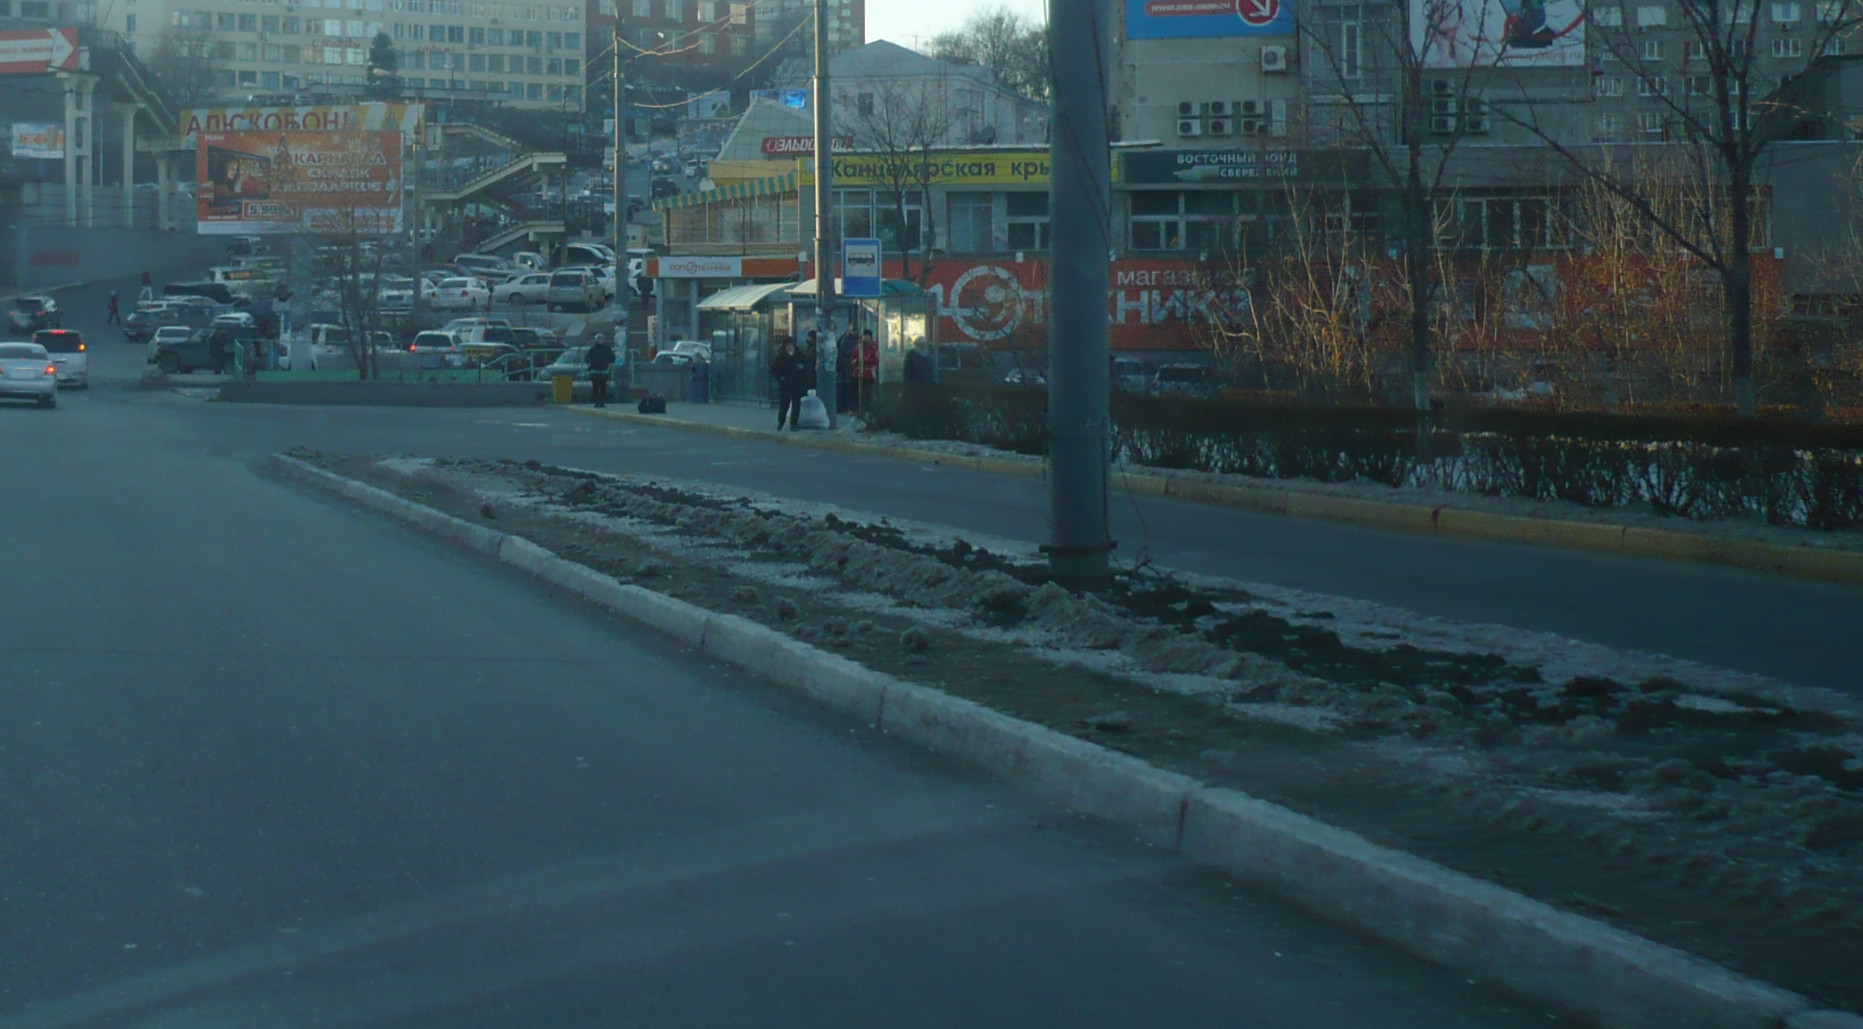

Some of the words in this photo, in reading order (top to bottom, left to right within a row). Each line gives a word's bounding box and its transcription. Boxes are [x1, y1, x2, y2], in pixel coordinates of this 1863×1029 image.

[776, 138, 848, 152] ЭЛЬДОДО
[1176, 153, 1256, 164] ВОСТОЧНЫЙ
[831, 159, 996, 187] Канцелярская
[1219, 167, 1298, 177] СБЕРЕЕНИЙ
